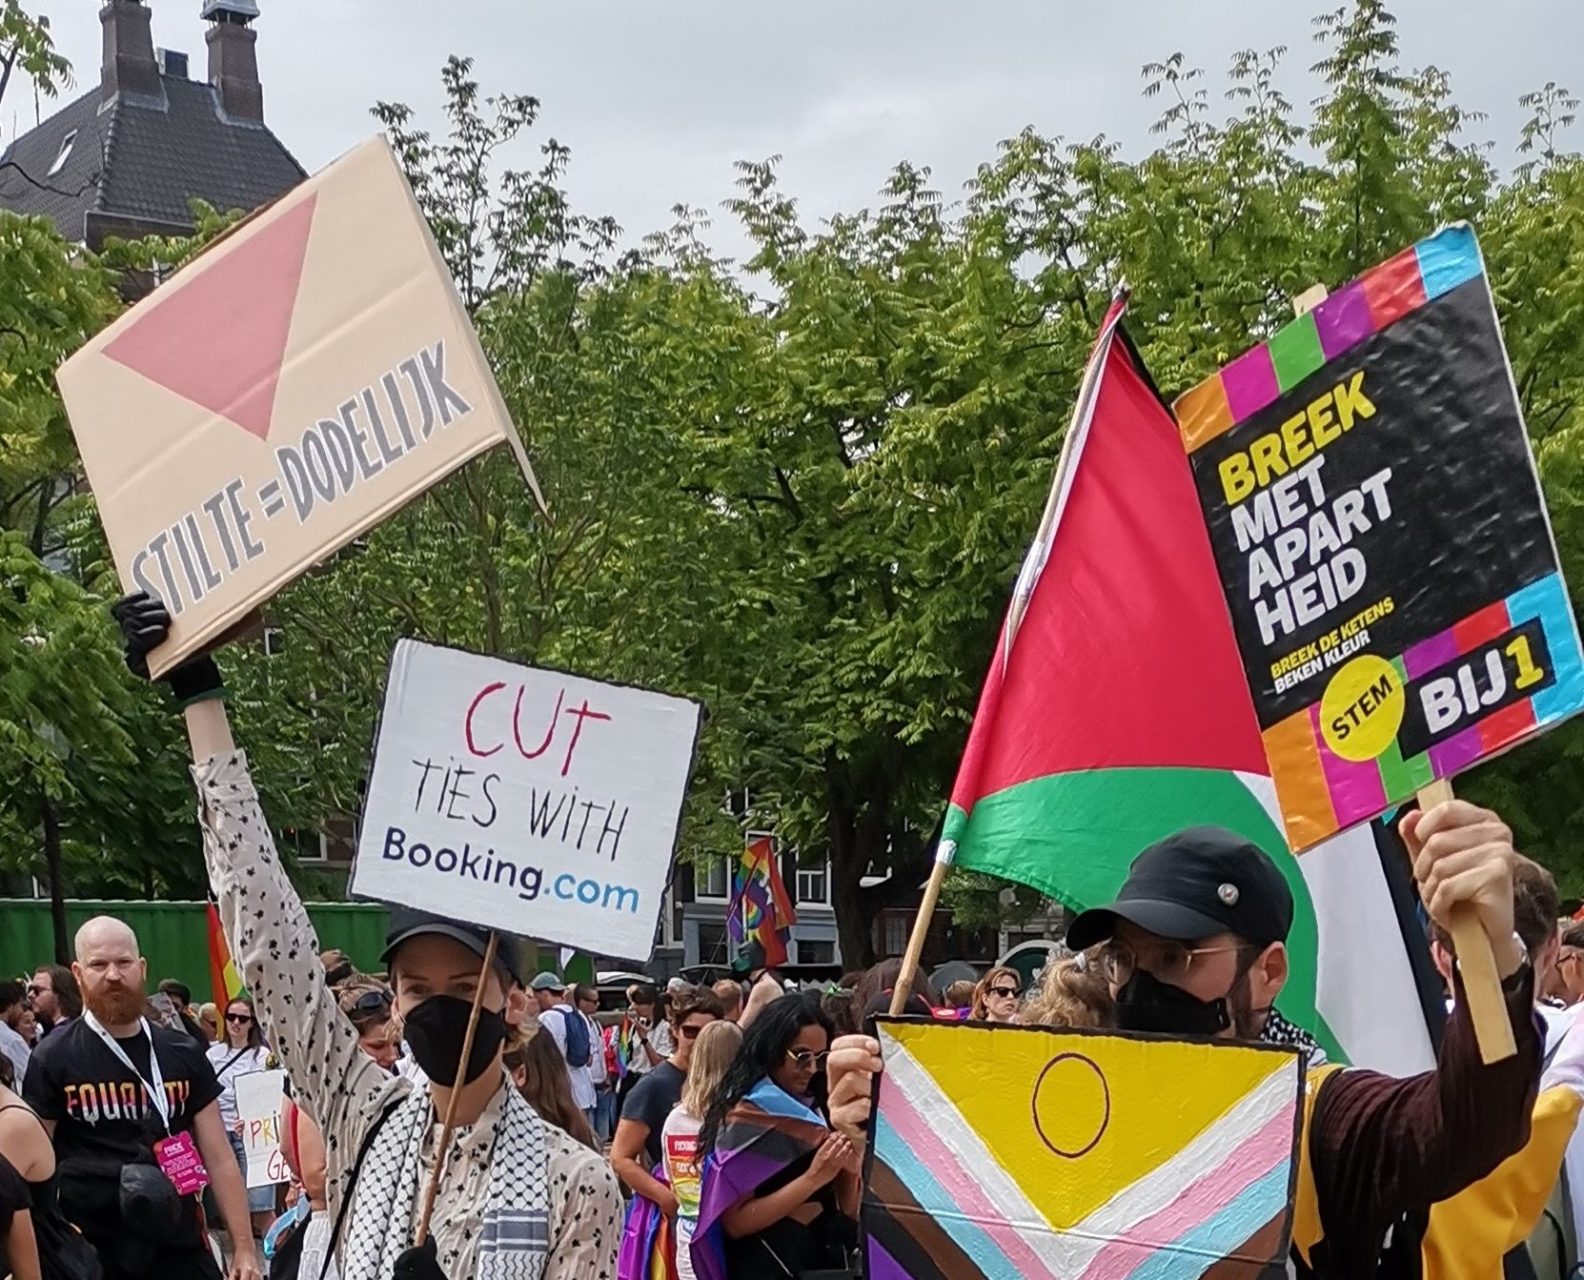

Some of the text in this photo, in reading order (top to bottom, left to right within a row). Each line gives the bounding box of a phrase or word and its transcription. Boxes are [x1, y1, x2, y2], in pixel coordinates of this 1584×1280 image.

[1219, 370, 1377, 506] BREEK
[1231, 454, 1326, 552] MET
[1248, 467, 1392, 600] APART
[1254, 547, 1367, 645] HEID
[1270, 596, 1395, 679] BREEK DE KETENS
[1274, 629, 1371, 694] BEKEN KLEUR
[1331, 673, 1393, 741] STEM
[1419, 634, 1544, 734] BIJ1
[465, 681, 612, 776] CUT
[382, 826, 640, 914] Booking.com
[64, 1080, 190, 1127] EQUALTY
